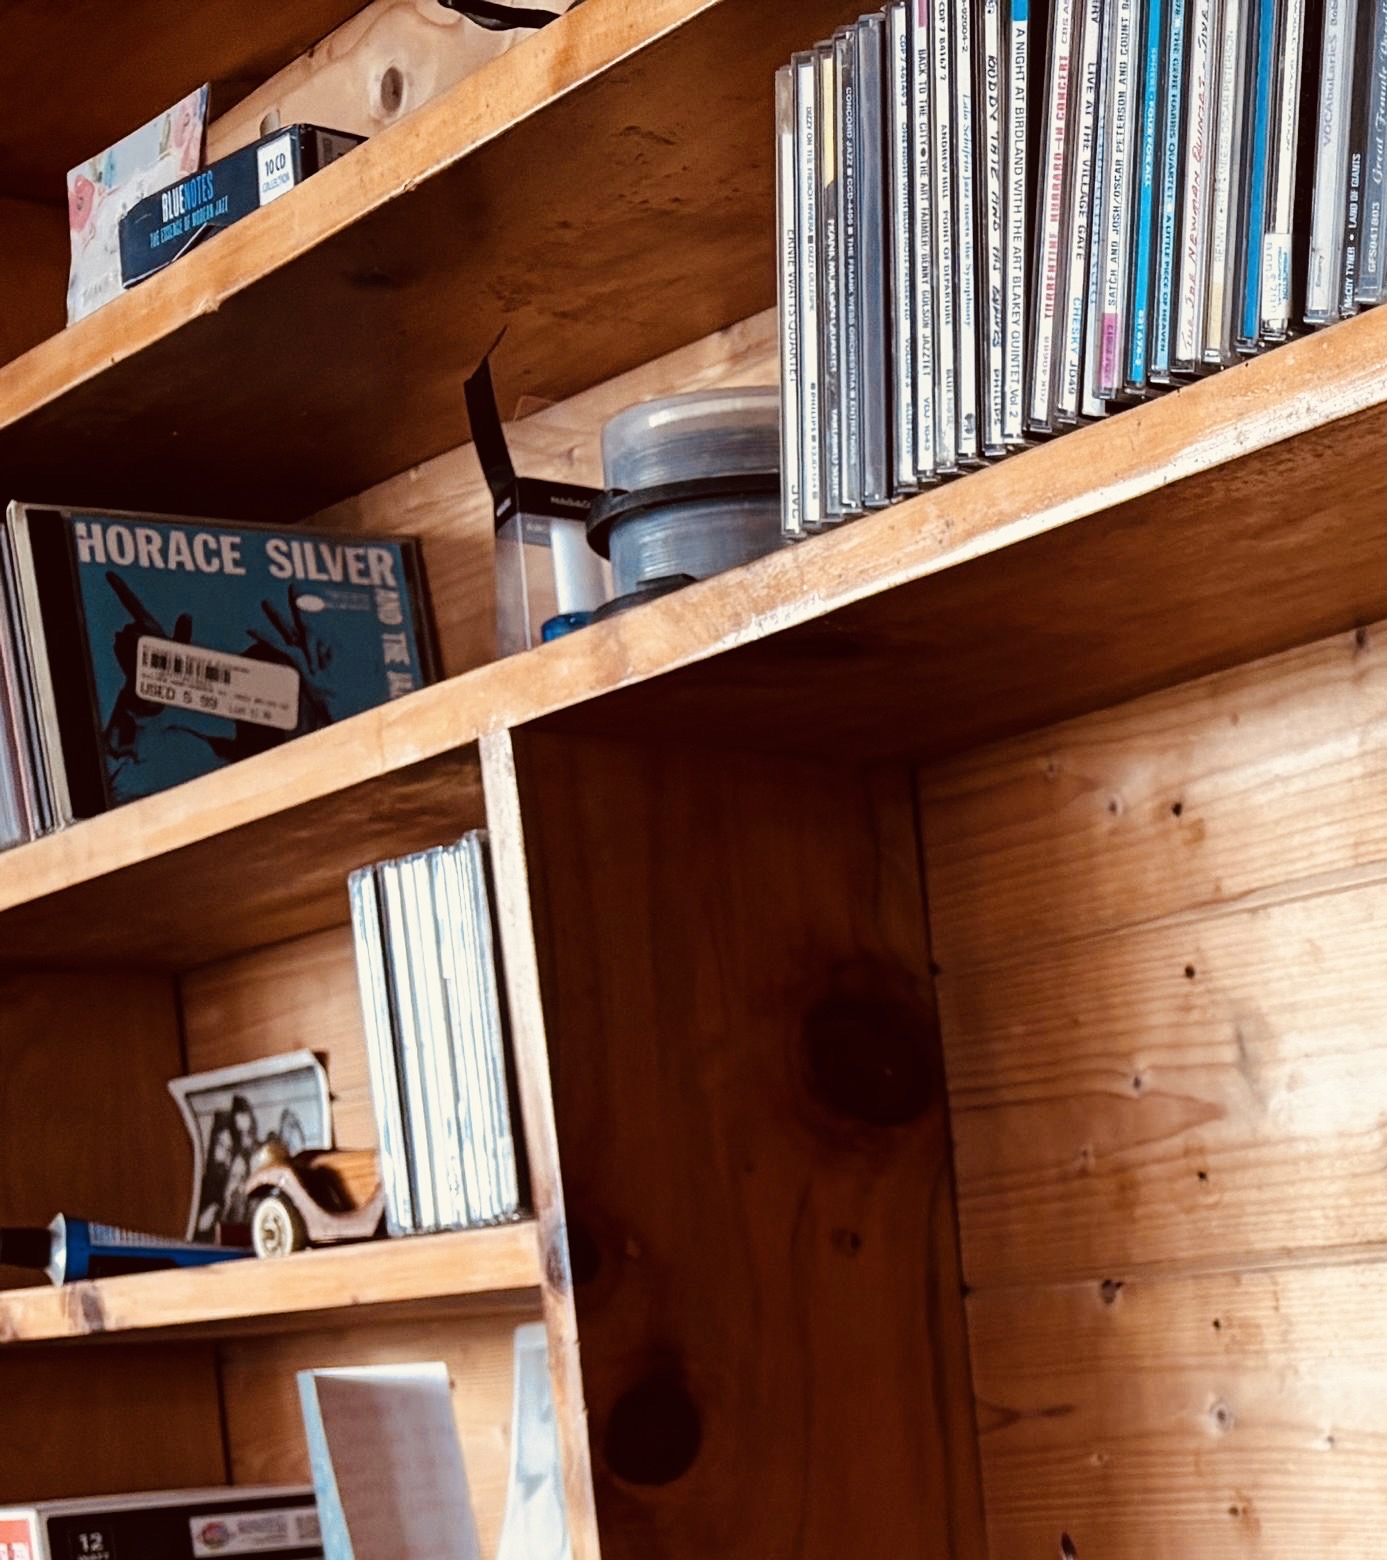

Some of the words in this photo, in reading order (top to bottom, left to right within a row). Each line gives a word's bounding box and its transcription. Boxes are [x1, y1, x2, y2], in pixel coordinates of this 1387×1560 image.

[1120, 16, 1129, 56] COUNT
[1172, 31, 1180, 55] THE
[917, 49, 927, 75] BACK
[1015, 42, 1026, 82] NIGHT
[1086, 62, 1096, 94] LIVE
[1118, 61, 1127, 85] AND
[917, 80, 927, 94] TO
[1015, 86, 1025, 103] AT
[845, 87, 853, 138] CONCORD
[918, 100, 928, 117] THE
[1084, 100, 1094, 117] AT
[1115, 91, 1127, 153] PETERSON
[918, 121, 928, 145] CITY
[940, 124, 948, 173] ANDREW
[1013, 107, 1025, 175] BIRDLAND
[1082, 125, 1093, 152] THE
[265, 160, 274, 176] 10
[275, 152, 286, 170] CD
[846, 140, 854, 165] JAZZ
[919, 160, 929, 177] THE
[1371, 136, 1384, 185] Great
[1166, 143, 1176, 199] QUARTET
[1350, 152, 1361, 187] GIANTS
[161, 170, 214, 222] BLUENOTES
[919, 182, 929, 201] ART
[1012, 179, 1024, 214] WITH
[1078, 159, 1091, 218] VILLAGE
[1012, 217, 1022, 243] THE
[1348, 203, 1358, 228] LAND
[1075, 224, 1086, 261] GATE
[1109, 241, 1119, 263] AND
[1164, 225, 1172, 257] LITTLE
[1012, 246, 1022, 271] ART
[1346, 247, 1356, 275] TYNER
[1011, 276, 1022, 325] BLAKEY
[1107, 268, 1118, 306] SATCH
[921, 290, 931, 328] GOLSON
[1070, 297, 1081, 355] CHESKY
[1160, 310, 1168, 352] HEAVEN
[922, 334, 931, 376] JAZZTET
[993, 368, 1002, 426] PHILIPS
[74, 521, 246, 576] HORACE
[265, 538, 398, 588] SILVER
[79, 1532, 103, 1552] 12
